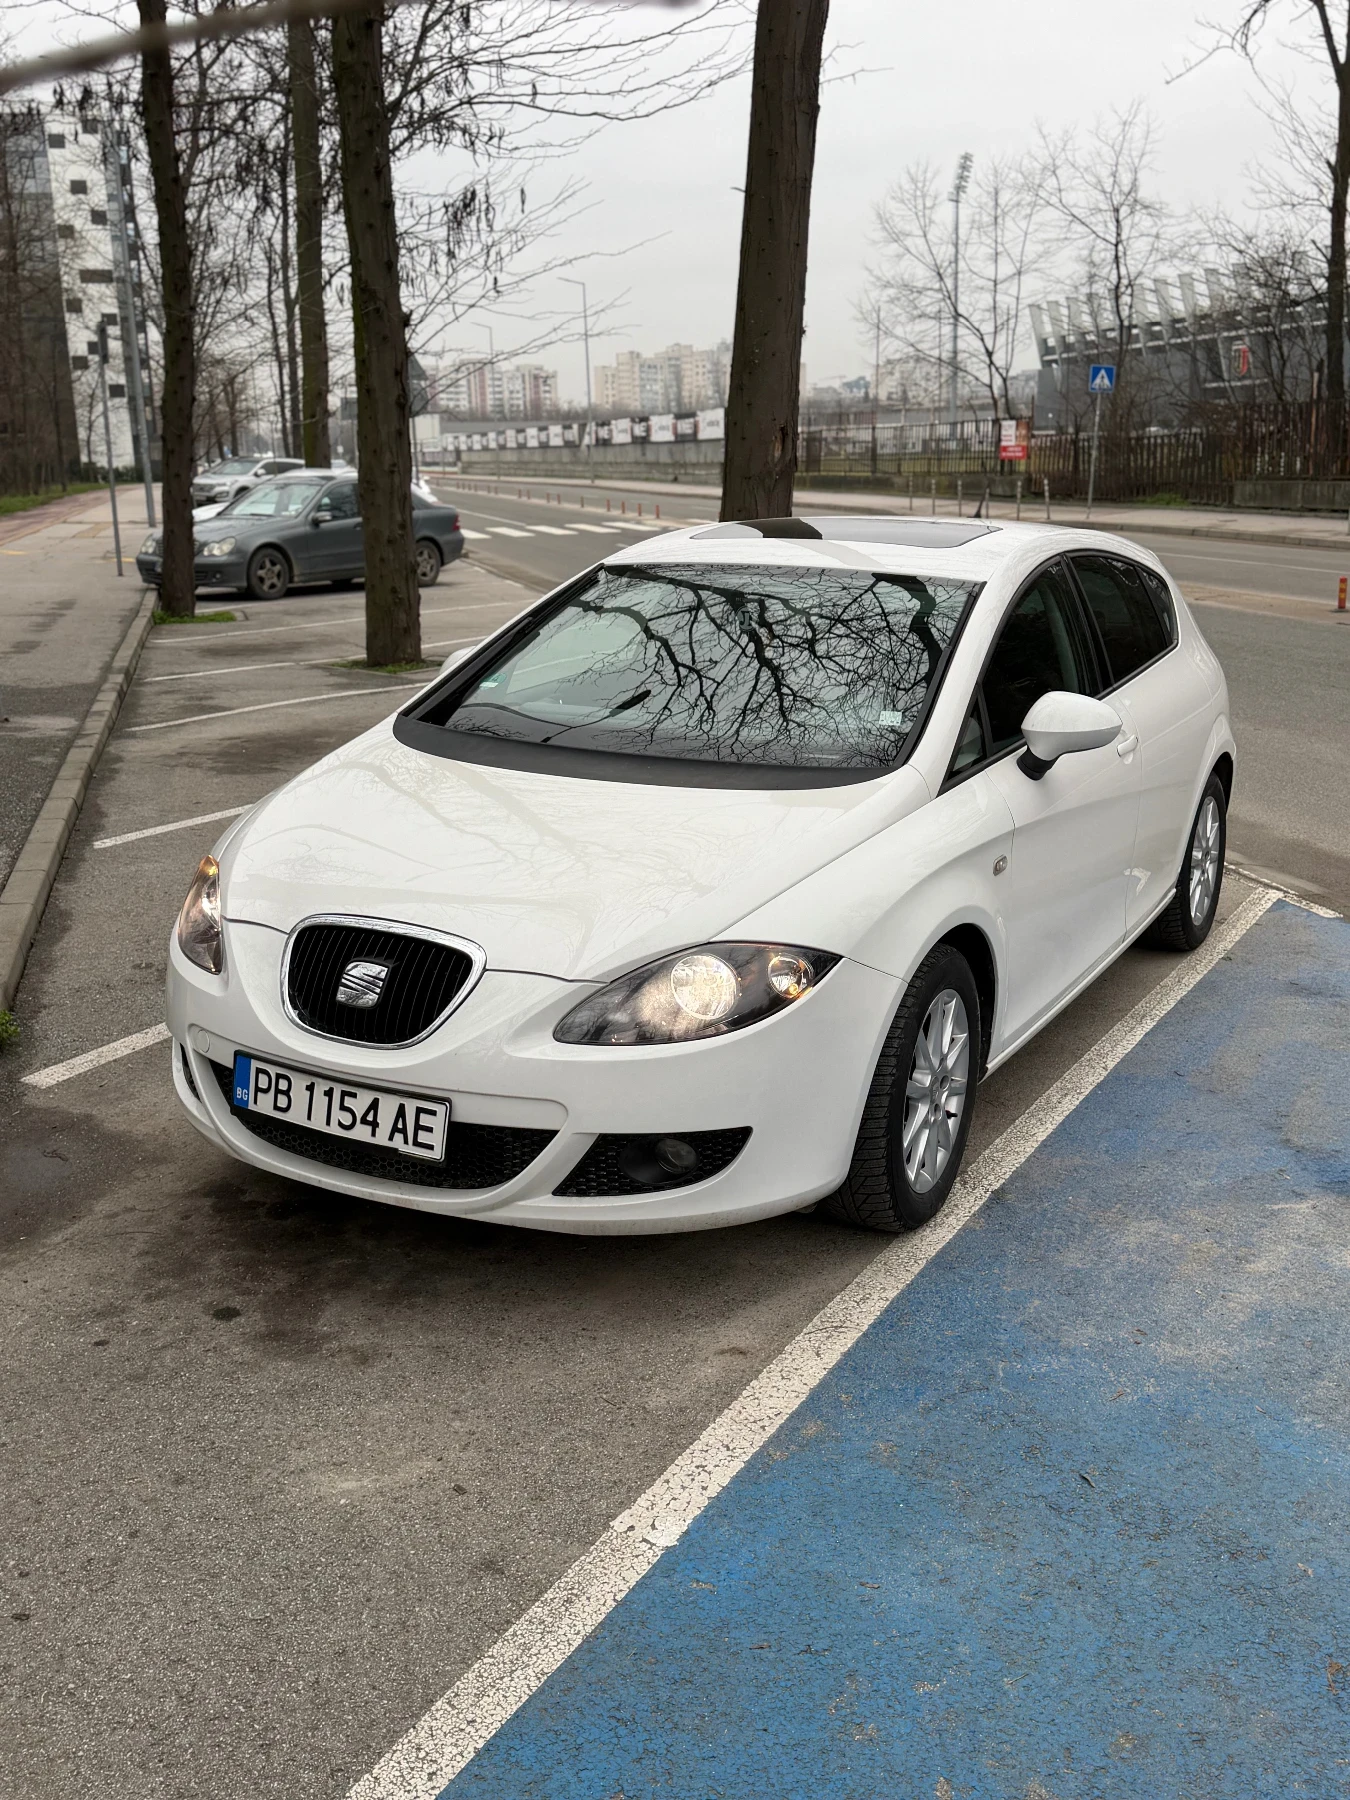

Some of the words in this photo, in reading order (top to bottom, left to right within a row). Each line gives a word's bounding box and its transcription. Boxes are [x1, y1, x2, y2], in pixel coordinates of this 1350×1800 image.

[236, 1087, 249, 1101] BG
[253, 1066, 293, 1113] PB
[305, 1081, 380, 1138] 1154
[388, 1102, 438, 1151] AE
